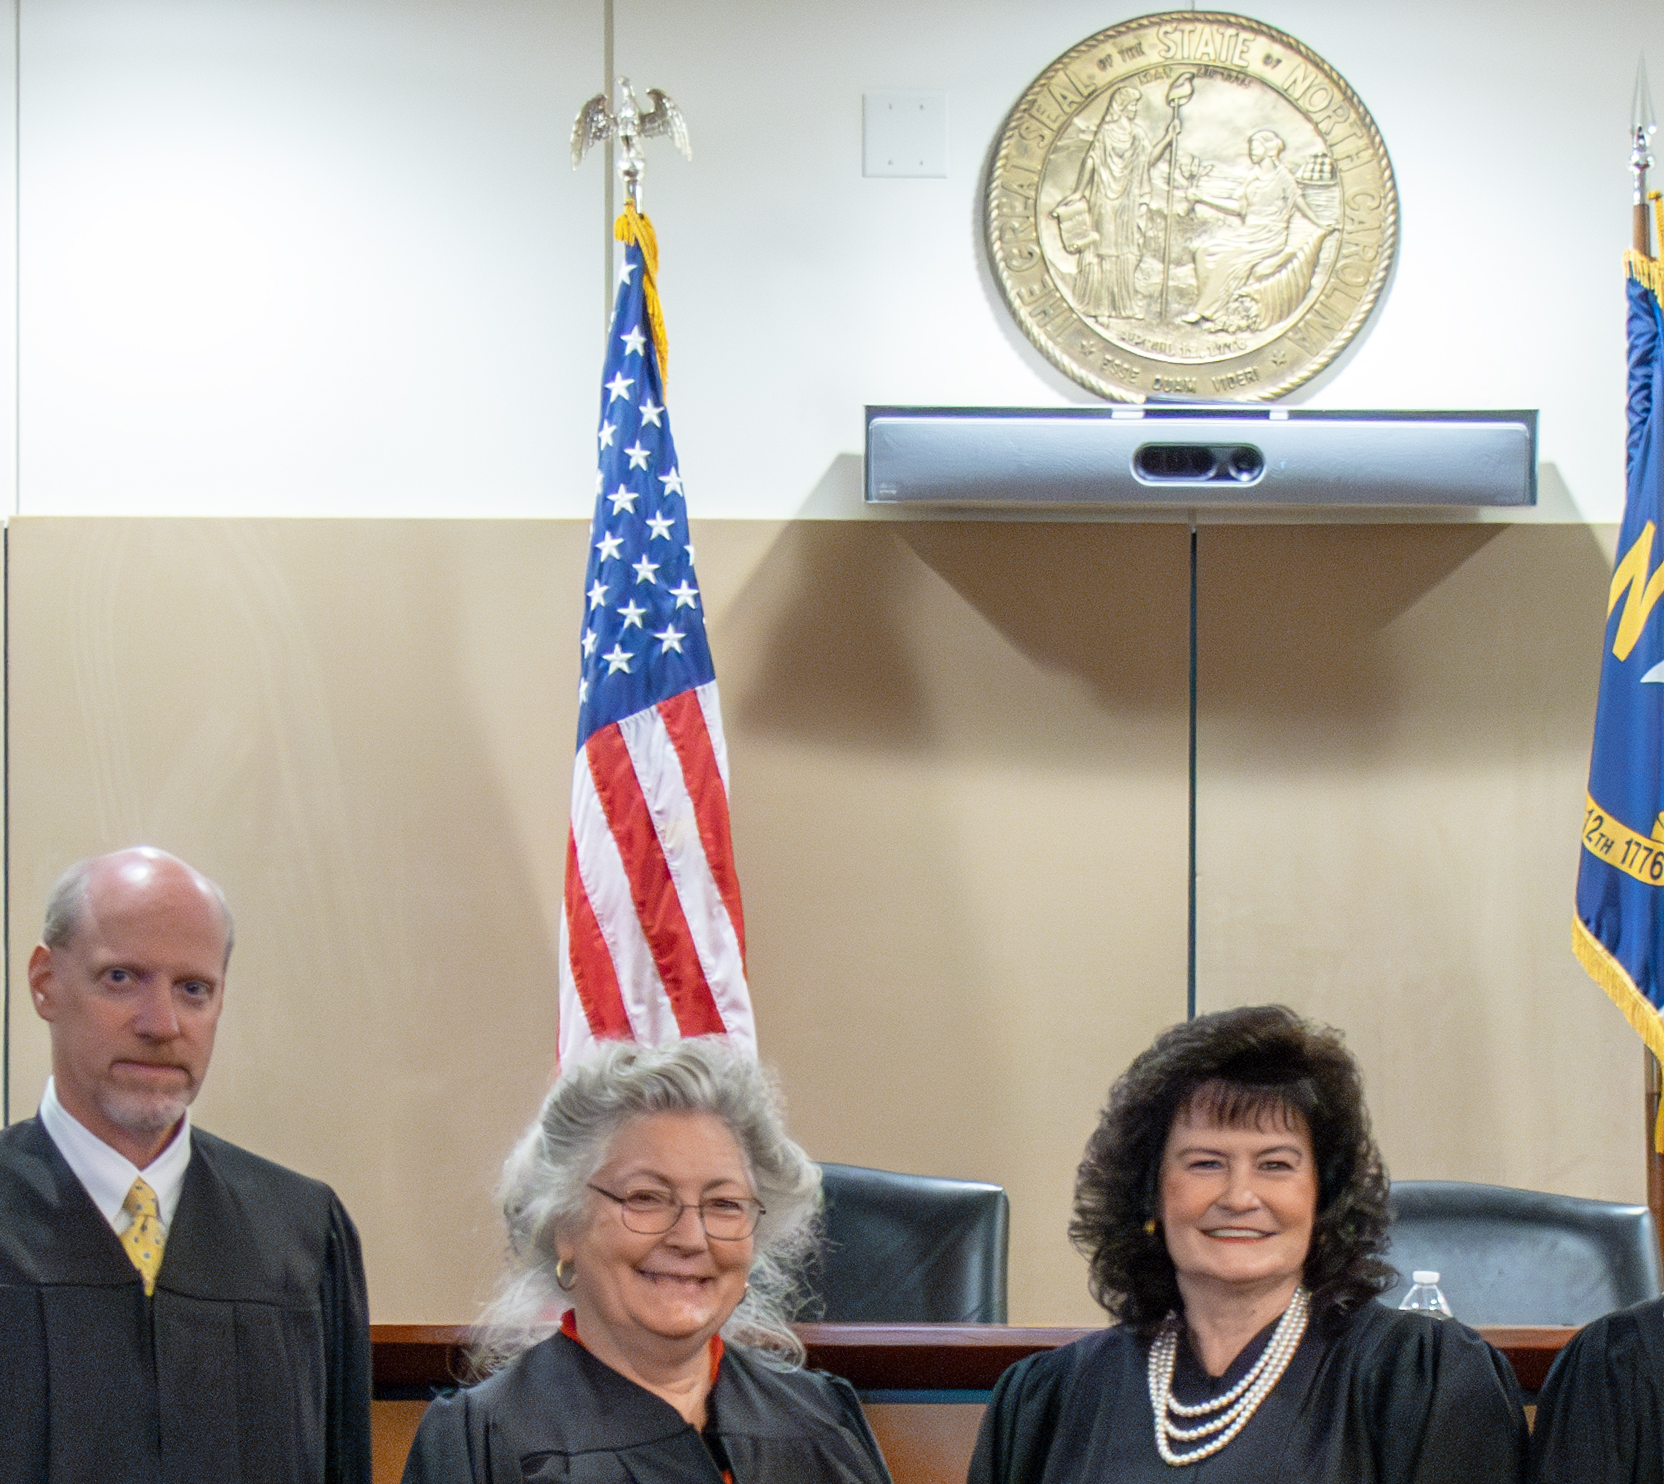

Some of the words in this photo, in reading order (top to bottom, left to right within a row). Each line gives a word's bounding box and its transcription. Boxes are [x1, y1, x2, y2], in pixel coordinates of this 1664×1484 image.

[1156, 23, 1256, 68] STATE
[1017, 68, 1096, 148] SEAL
[1281, 62, 1377, 172] NORTH
[1286, 187, 1382, 358] CAROLINA
